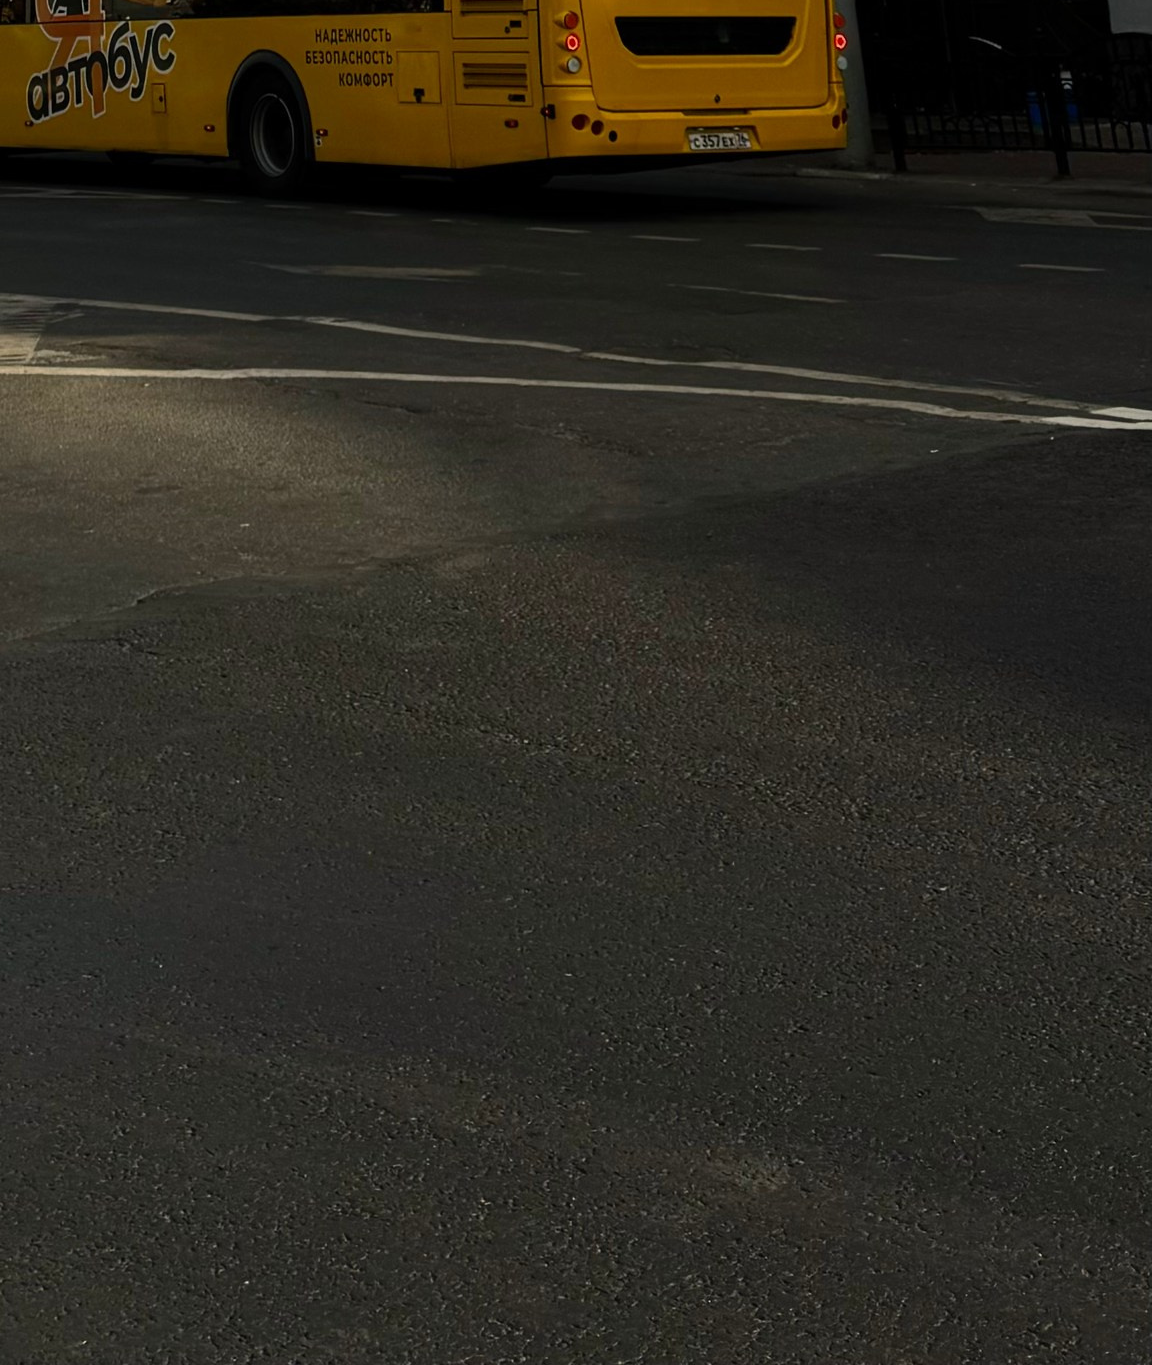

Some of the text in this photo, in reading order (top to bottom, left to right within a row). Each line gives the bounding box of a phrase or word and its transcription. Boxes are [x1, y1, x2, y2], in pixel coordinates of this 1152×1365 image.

[314, 27, 392, 45] НАДЕЖНОСТЬ
[305, 50, 393, 65] БЕЗОПАСНОСТЬ
[26, 19, 177, 124] автобус
[338, 72, 394, 87] КОМФОРТ
